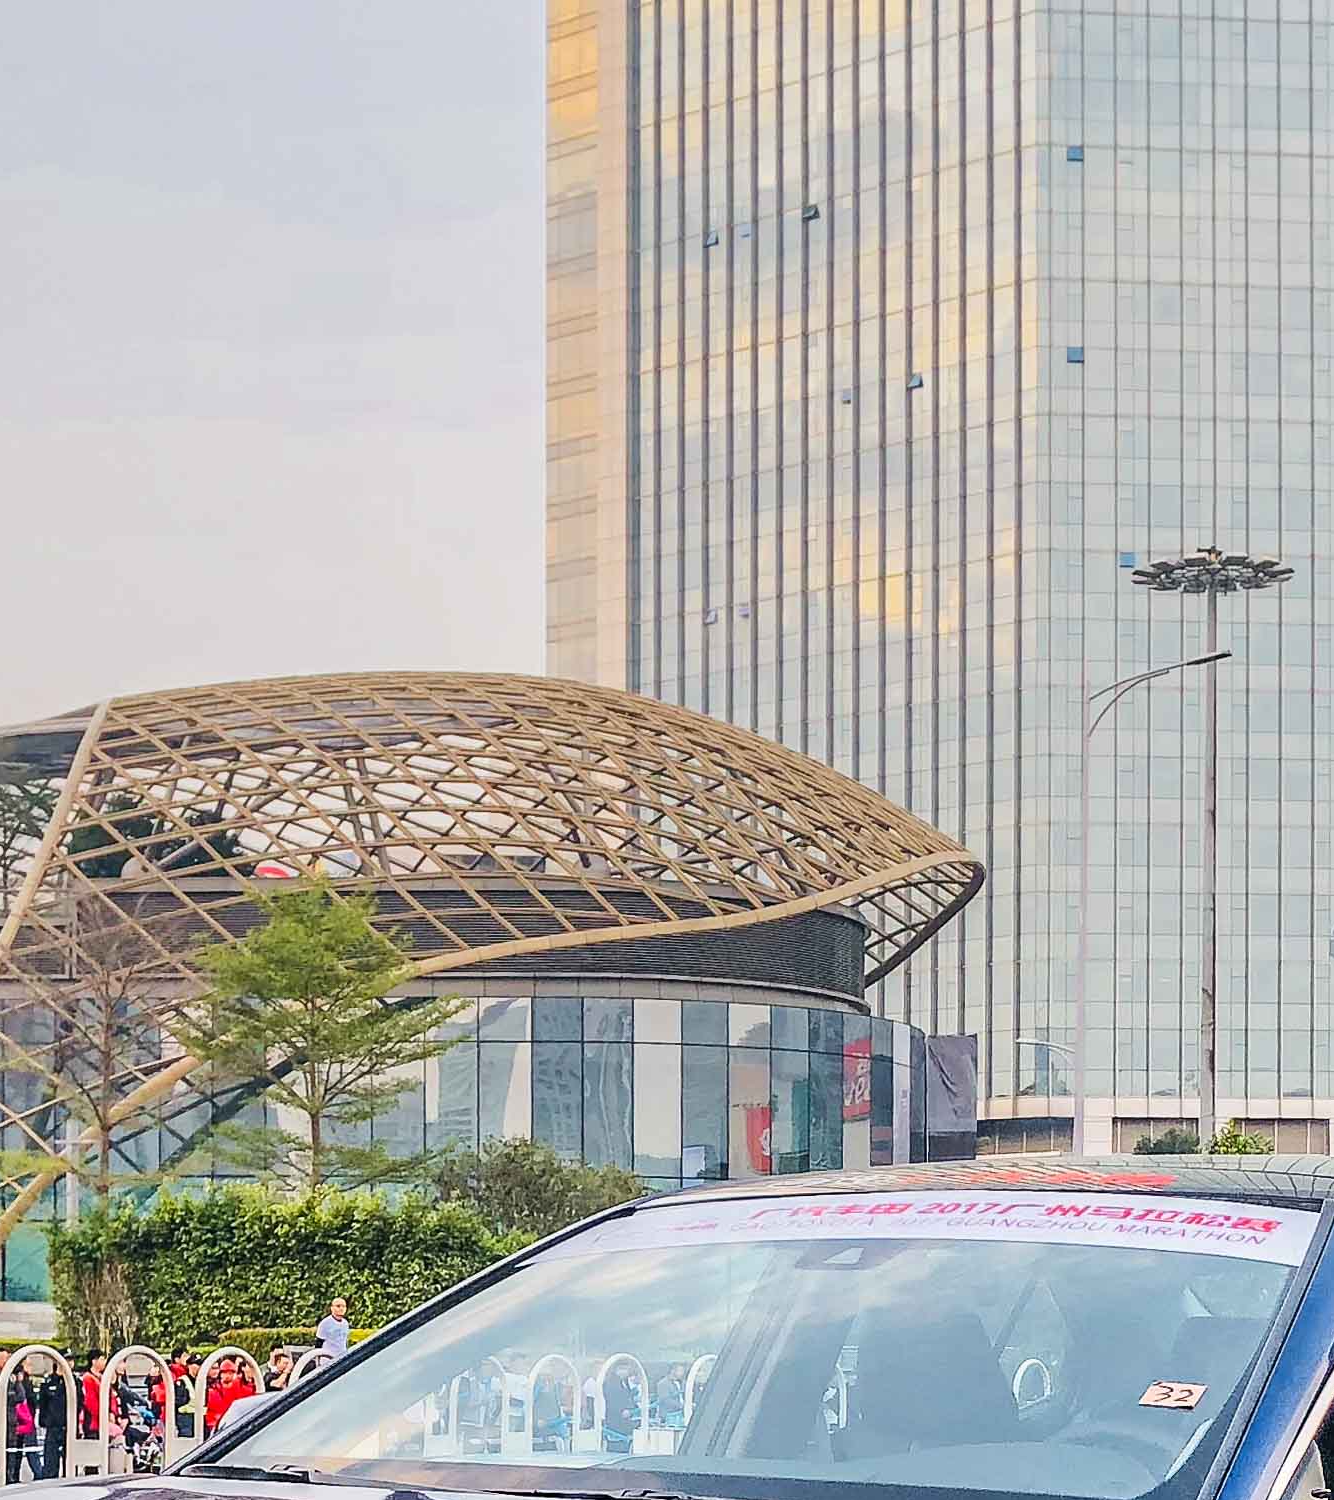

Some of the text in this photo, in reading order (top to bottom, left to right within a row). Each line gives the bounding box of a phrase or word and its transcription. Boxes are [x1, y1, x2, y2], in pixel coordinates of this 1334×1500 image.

[946, 1217, 1107, 1231] GUANGZHOU
[1114, 1223, 1266, 1245] MARATHON
[1153, 1384, 1194, 1402] 32
